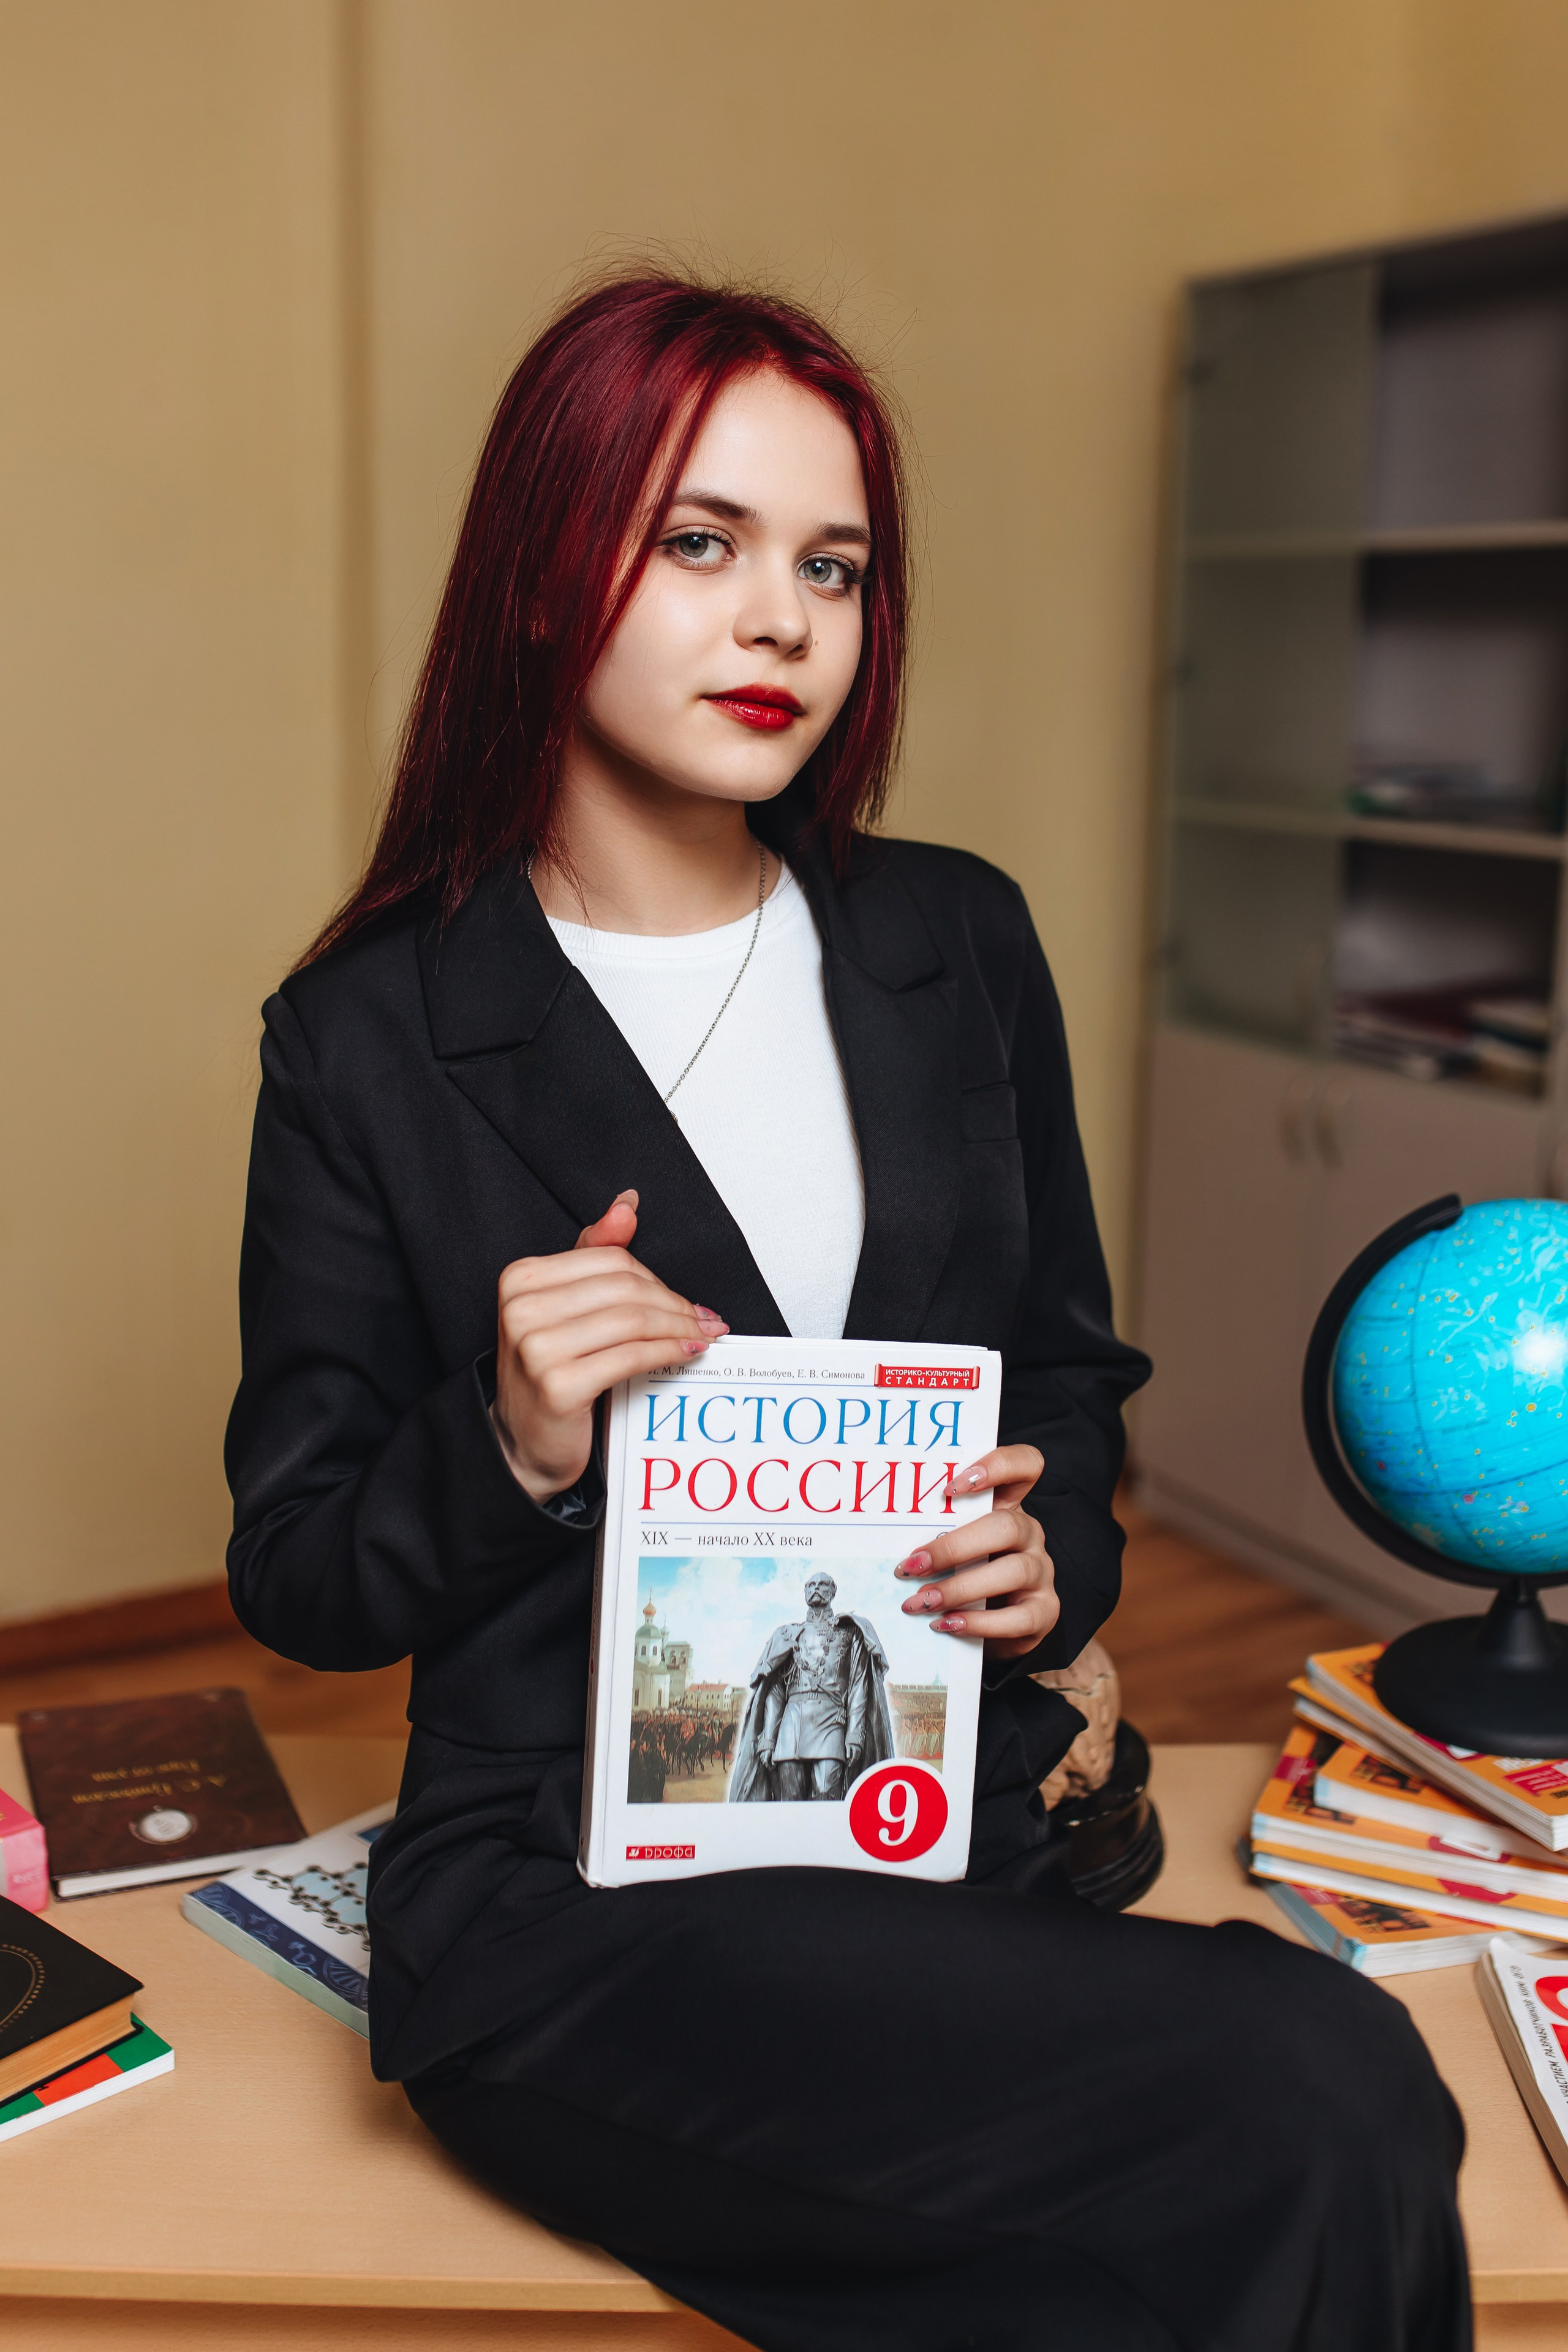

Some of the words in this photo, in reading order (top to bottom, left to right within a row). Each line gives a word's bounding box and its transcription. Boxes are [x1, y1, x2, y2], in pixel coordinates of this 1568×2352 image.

[662, 1366, 674, 1375] М.
[676, 1366, 721, 1377] Ляшенко,
[723, 1367, 734, 1376] О.
[737, 1368, 747, 1377] В.
[749, 1368, 794, 1379] Волобуев,
[797, 1369, 806, 1378] Е.
[809, 1370, 818, 1378] В.
[821, 1370, 865, 1379] Симонова
[885, 1368, 970, 1377] ИСТОРИКО-КУЛЬТУРНЫЙ
[885, 1376, 969, 1387] СТАНДАРТ
[643, 1393, 965, 1452] ИСТОРИЯ
[638, 1457, 959, 1514] РОССИИ
[640, 1531, 669, 1545] XIX
[698, 1534, 749, 1546] начало
[753, 1531, 775, 1546] XX
[780, 1534, 813, 1547] века
[877, 1779, 919, 1847] 9
